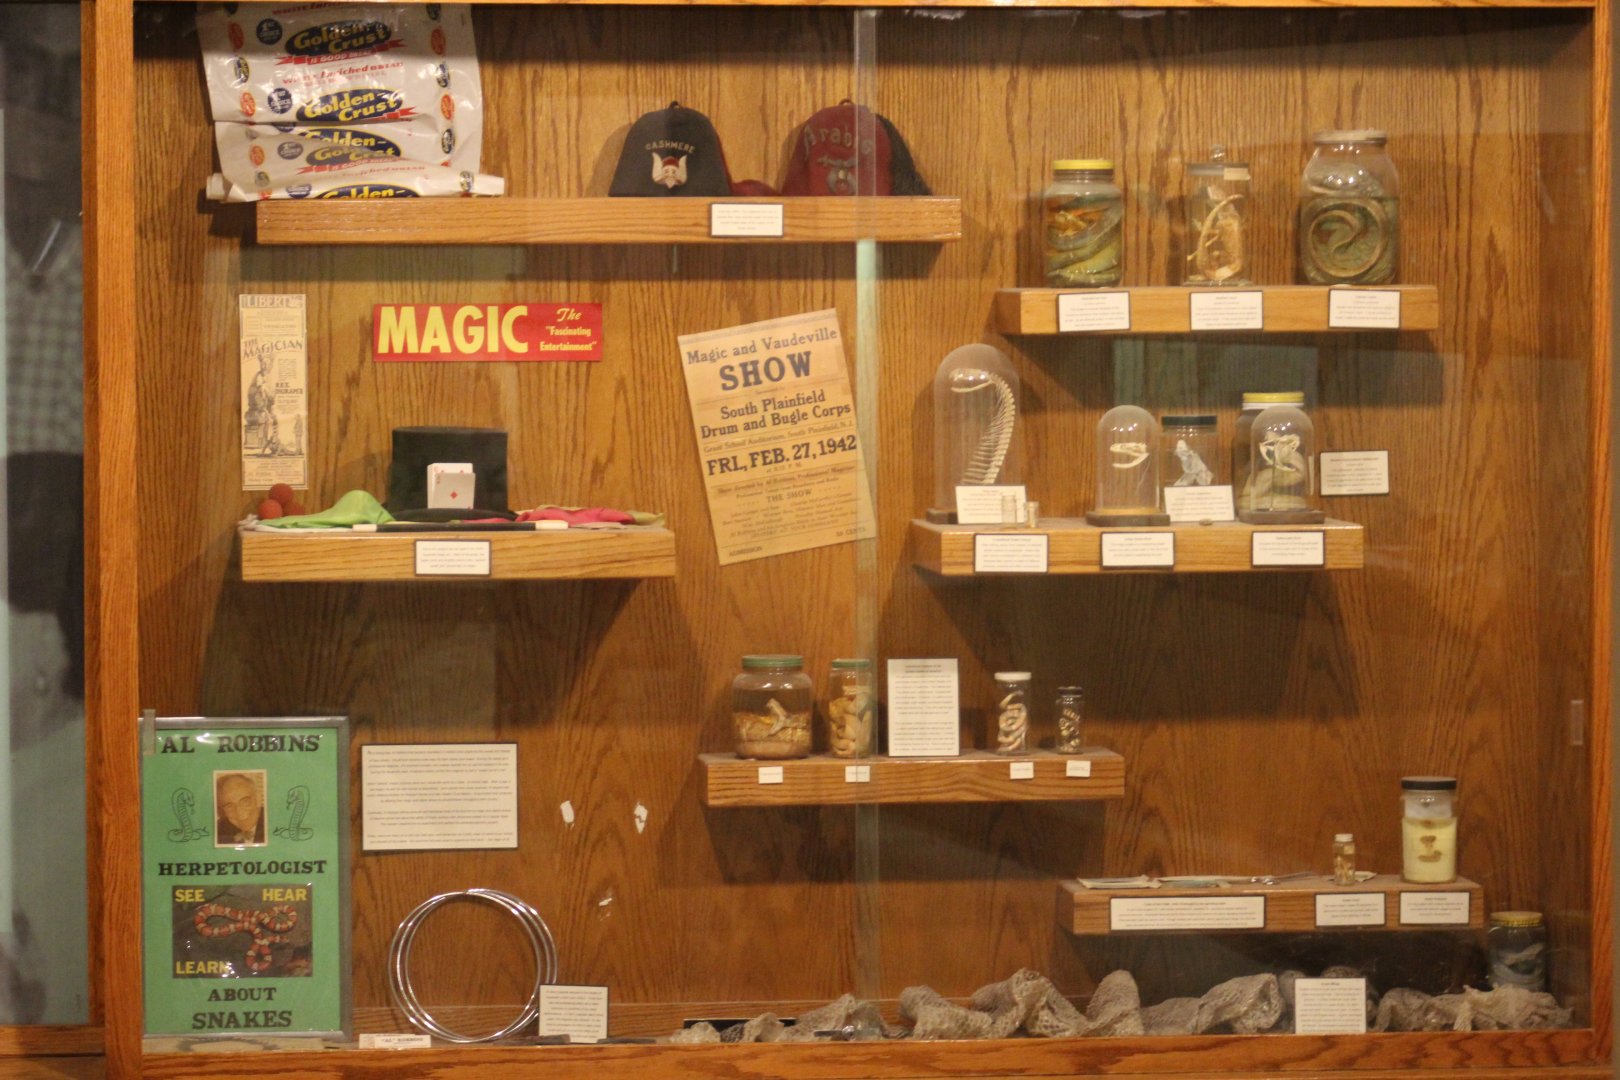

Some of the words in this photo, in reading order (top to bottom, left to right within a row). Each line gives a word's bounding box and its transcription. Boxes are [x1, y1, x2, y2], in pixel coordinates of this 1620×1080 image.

[338, 95, 399, 122] Crust
[645, 140, 696, 154] CASHMERE
[556, 308, 582, 322] The
[377, 305, 529, 354] MAGIC
[243, 339, 303, 360] MAGICIAN
[687, 346, 728, 365] Magic
[732, 340, 758, 356] and
[761, 327, 838, 350] Vaudeville
[719, 351, 812, 391] SHOW
[720, 401, 758, 420] South
[762, 389, 826, 412] Plainfield
[700, 420, 738, 439] Drum
[743, 415, 767, 431] and
[772, 406, 809, 426] Bugle
[812, 402, 852, 421] Corps
[749, 447, 790, 469] FEB.
[792, 442, 817, 461] 27,
[818, 434, 857, 456] 1942
[786, 488, 813, 500] SHOW
[161, 736, 195, 754] AL
[217, 734, 321, 754] ROBBINS
[158, 860, 327, 876] HERPETOLOGIST
[174, 889, 206, 902] SEE
[262, 888, 307, 902] HEAR
[175, 961, 229, 975] LEARN
[207, 987, 277, 1002] ABOUT
[192, 1010, 293, 1030] SNAKES
